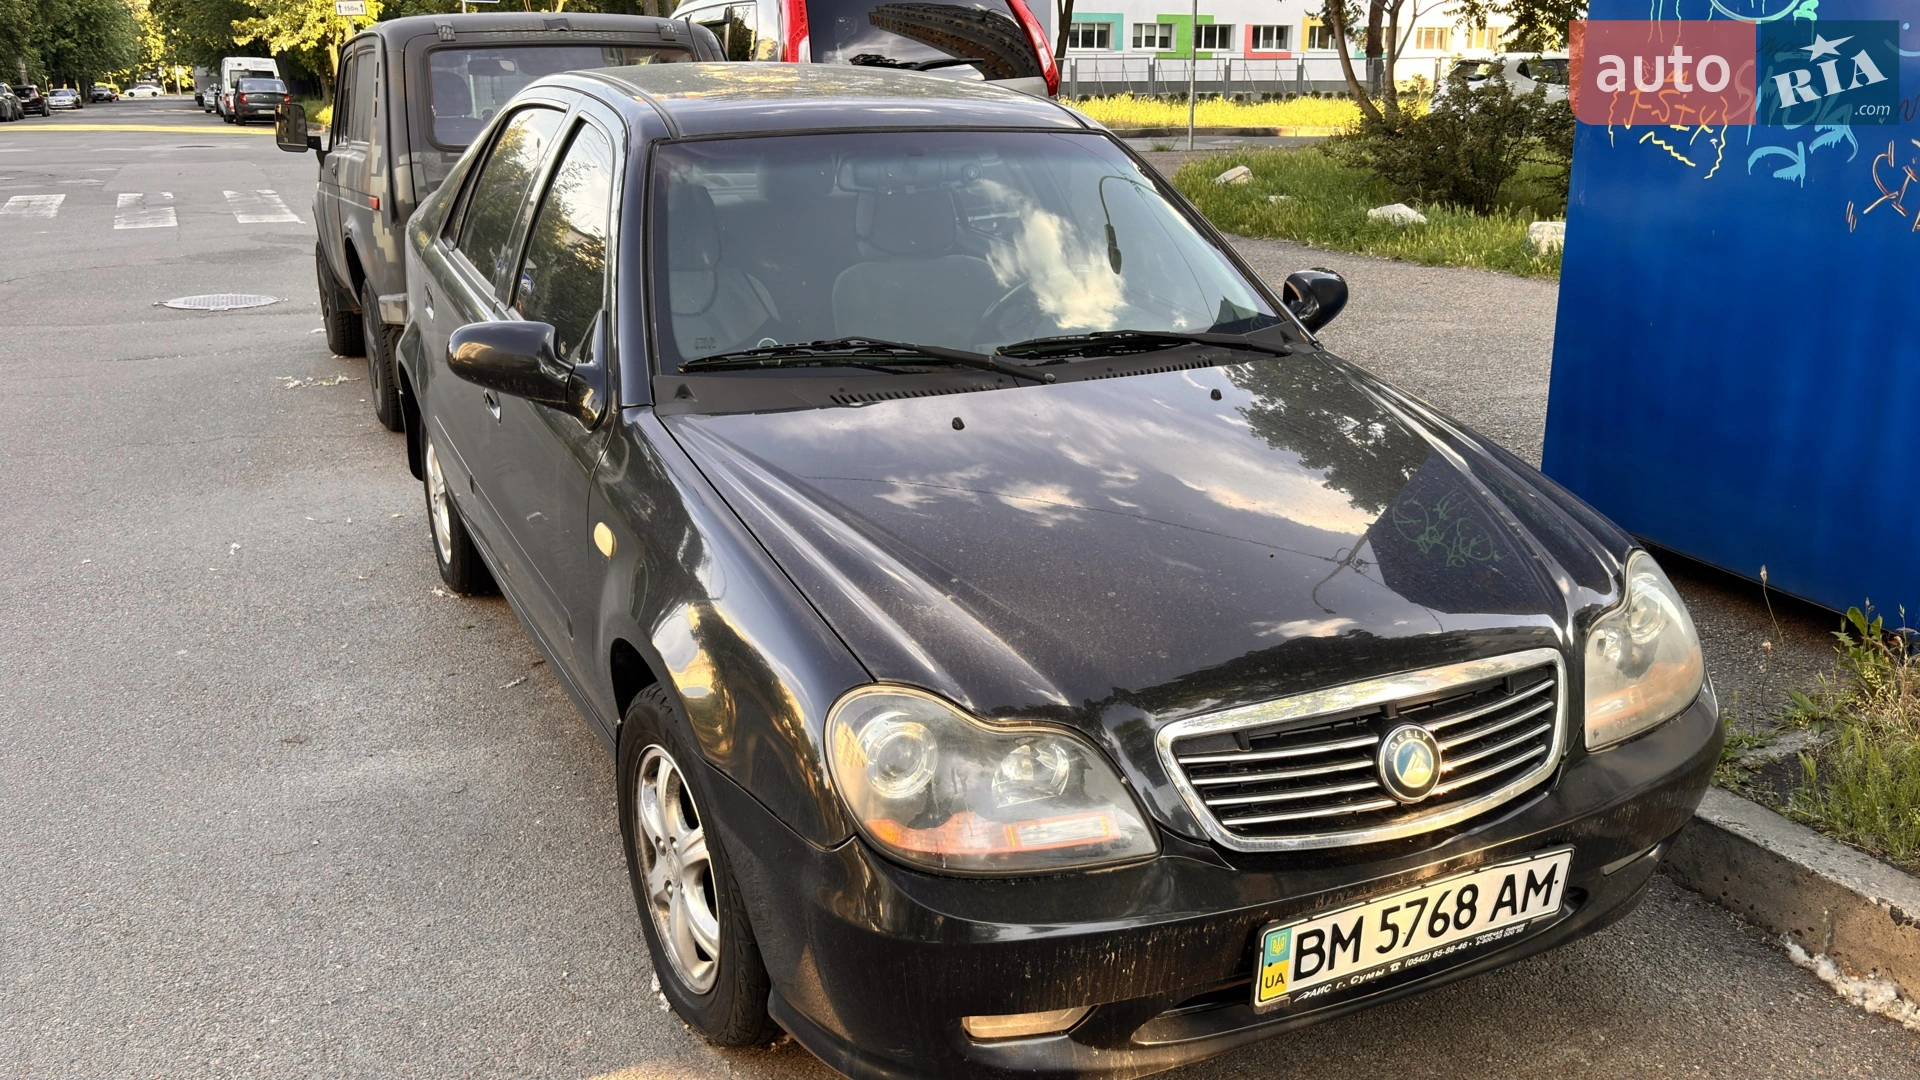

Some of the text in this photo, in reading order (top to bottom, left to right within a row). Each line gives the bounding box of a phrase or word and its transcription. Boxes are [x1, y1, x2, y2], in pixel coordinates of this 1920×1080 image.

[1390, 730, 1429, 750] GEELY
[1293, 863, 1558, 982] BM 5768 AM
[1265, 972, 1285, 989] UA
[1350, 968, 1385, 985] Сумы
